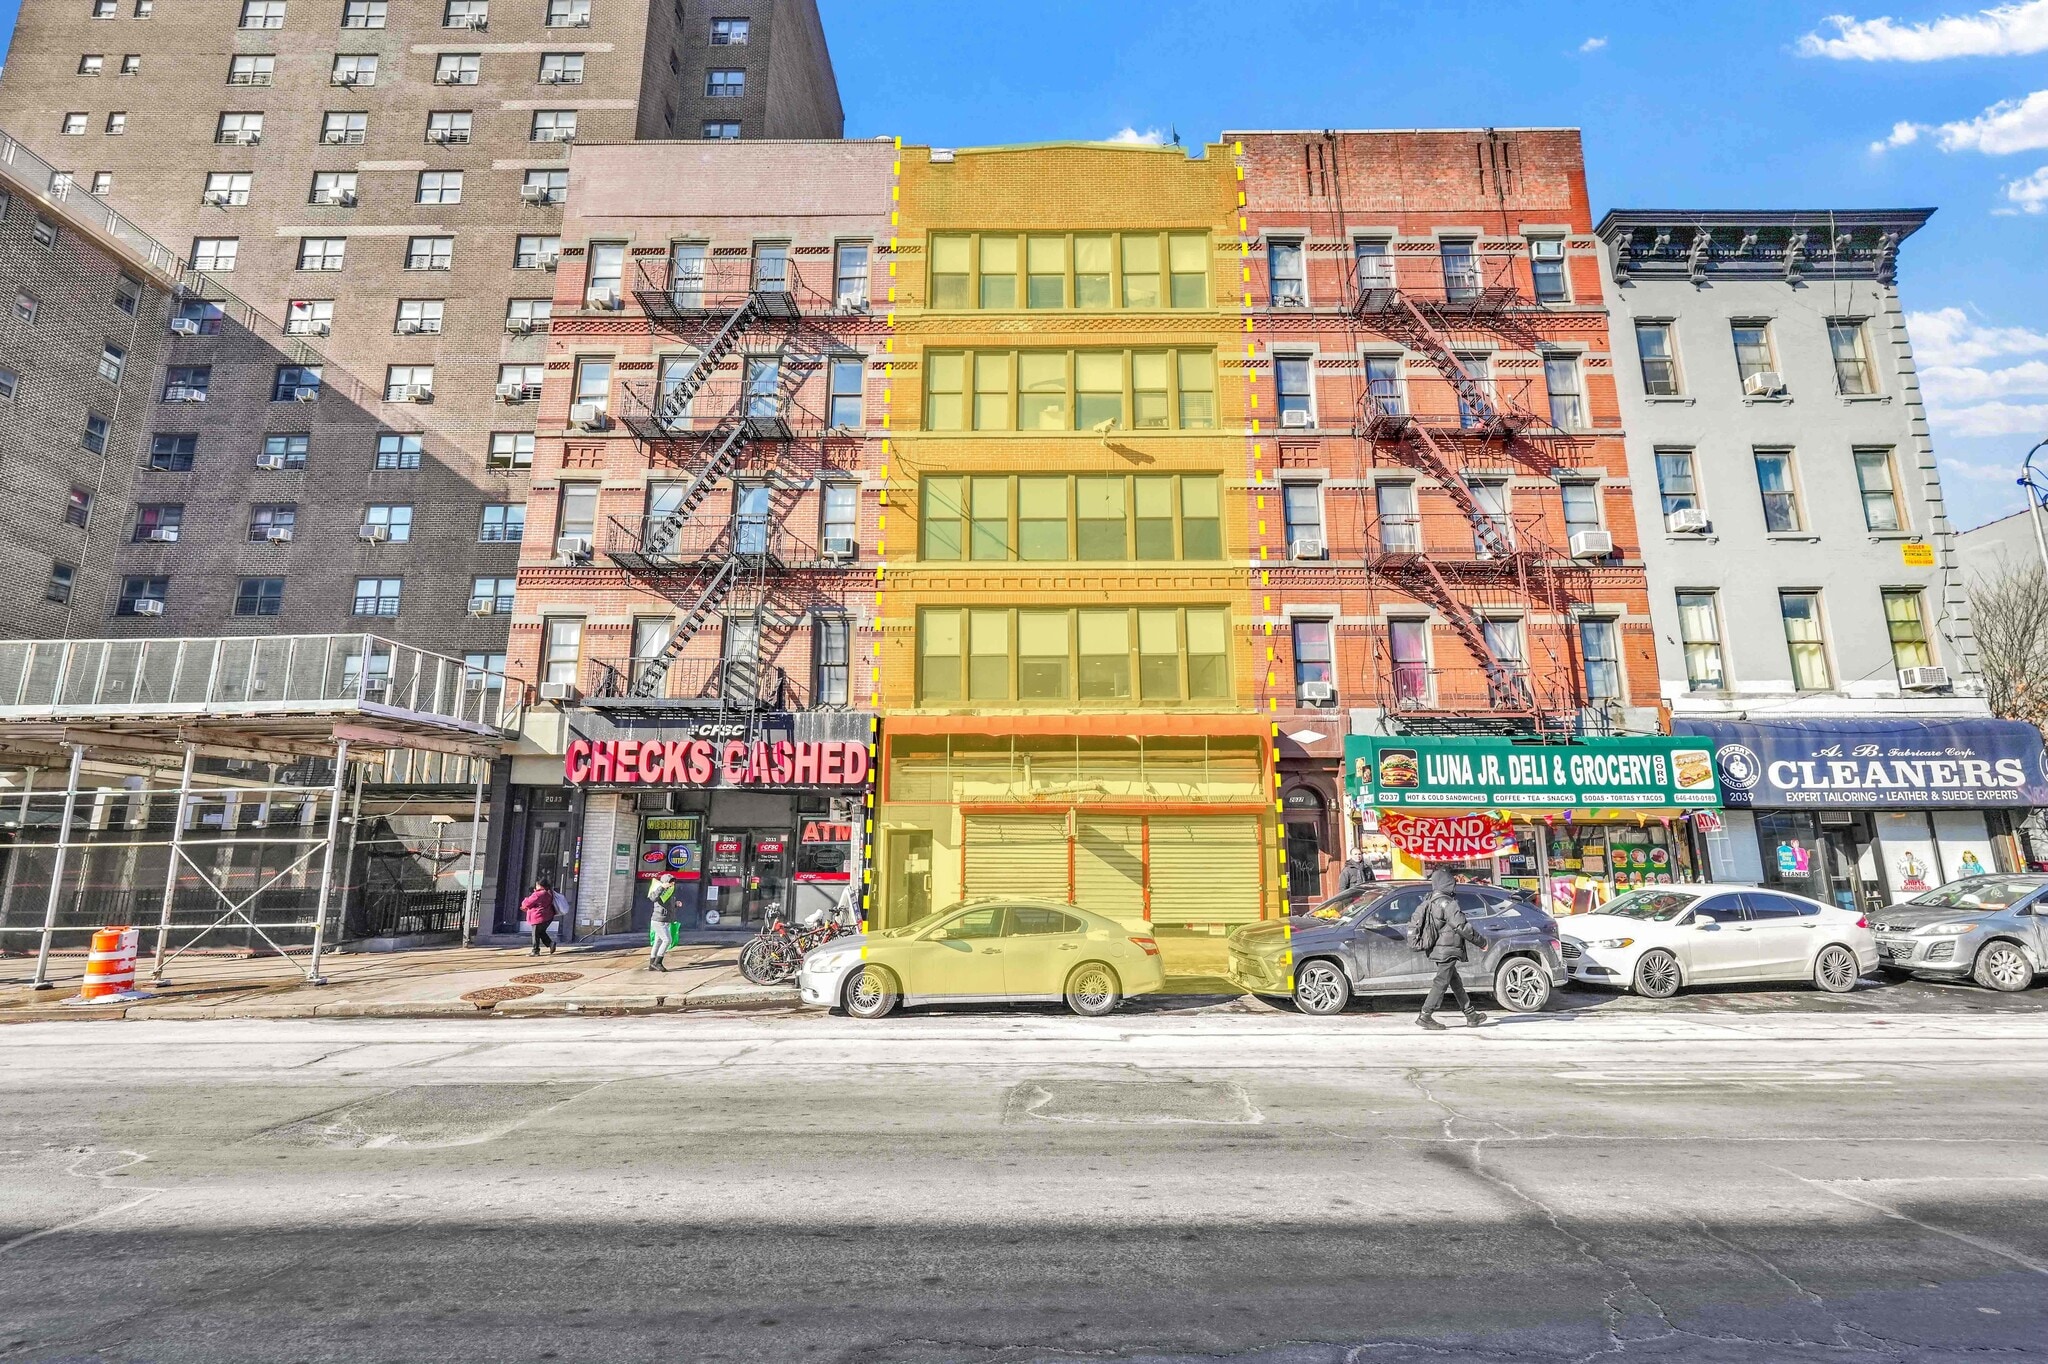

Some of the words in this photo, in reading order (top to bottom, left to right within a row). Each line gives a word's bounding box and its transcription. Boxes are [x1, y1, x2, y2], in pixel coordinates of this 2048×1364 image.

[699, 724, 745, 736] CFSC
[1720, 746, 1751, 756] EXPERT
[1811, 744, 1843, 757] A.
[1852, 744, 1884, 757] B.
[1887, 748, 1943, 757] Fabricare
[1945, 748, 1976, 759] Corp.
[565, 740, 714, 784] CHECKS
[720, 740, 867, 784] CASHED
[1426, 754, 1475, 785] LUNA
[1478, 754, 1505, 785] JR.
[1508, 754, 1549, 785] DELI
[1553, 754, 1567, 785] &
[1570, 754, 1651, 785] GROCERY
[1768, 758, 2026, 789] CLEANERS
[1721, 774, 1758, 788] TAILORING
[1730, 792, 1754, 802] 2039
[1786, 792, 1821, 802] EXPERT
[1824, 792, 1877, 802] TAILORING
[1887, 791, 1929, 801] LEATHER
[1932, 791, 1940, 801] &
[1942, 790, 1974, 800] SUEDE
[1976, 790, 2018, 800] EXPERTS
[647, 820, 689, 829] WESTERN
[802, 821, 852, 842] ATM
[1397, 819, 1484, 837] GRAND
[659, 830, 689, 839] UNION
[1390, 834, 1497, 853] OPENING
[1552, 842, 1574, 850] ATM
